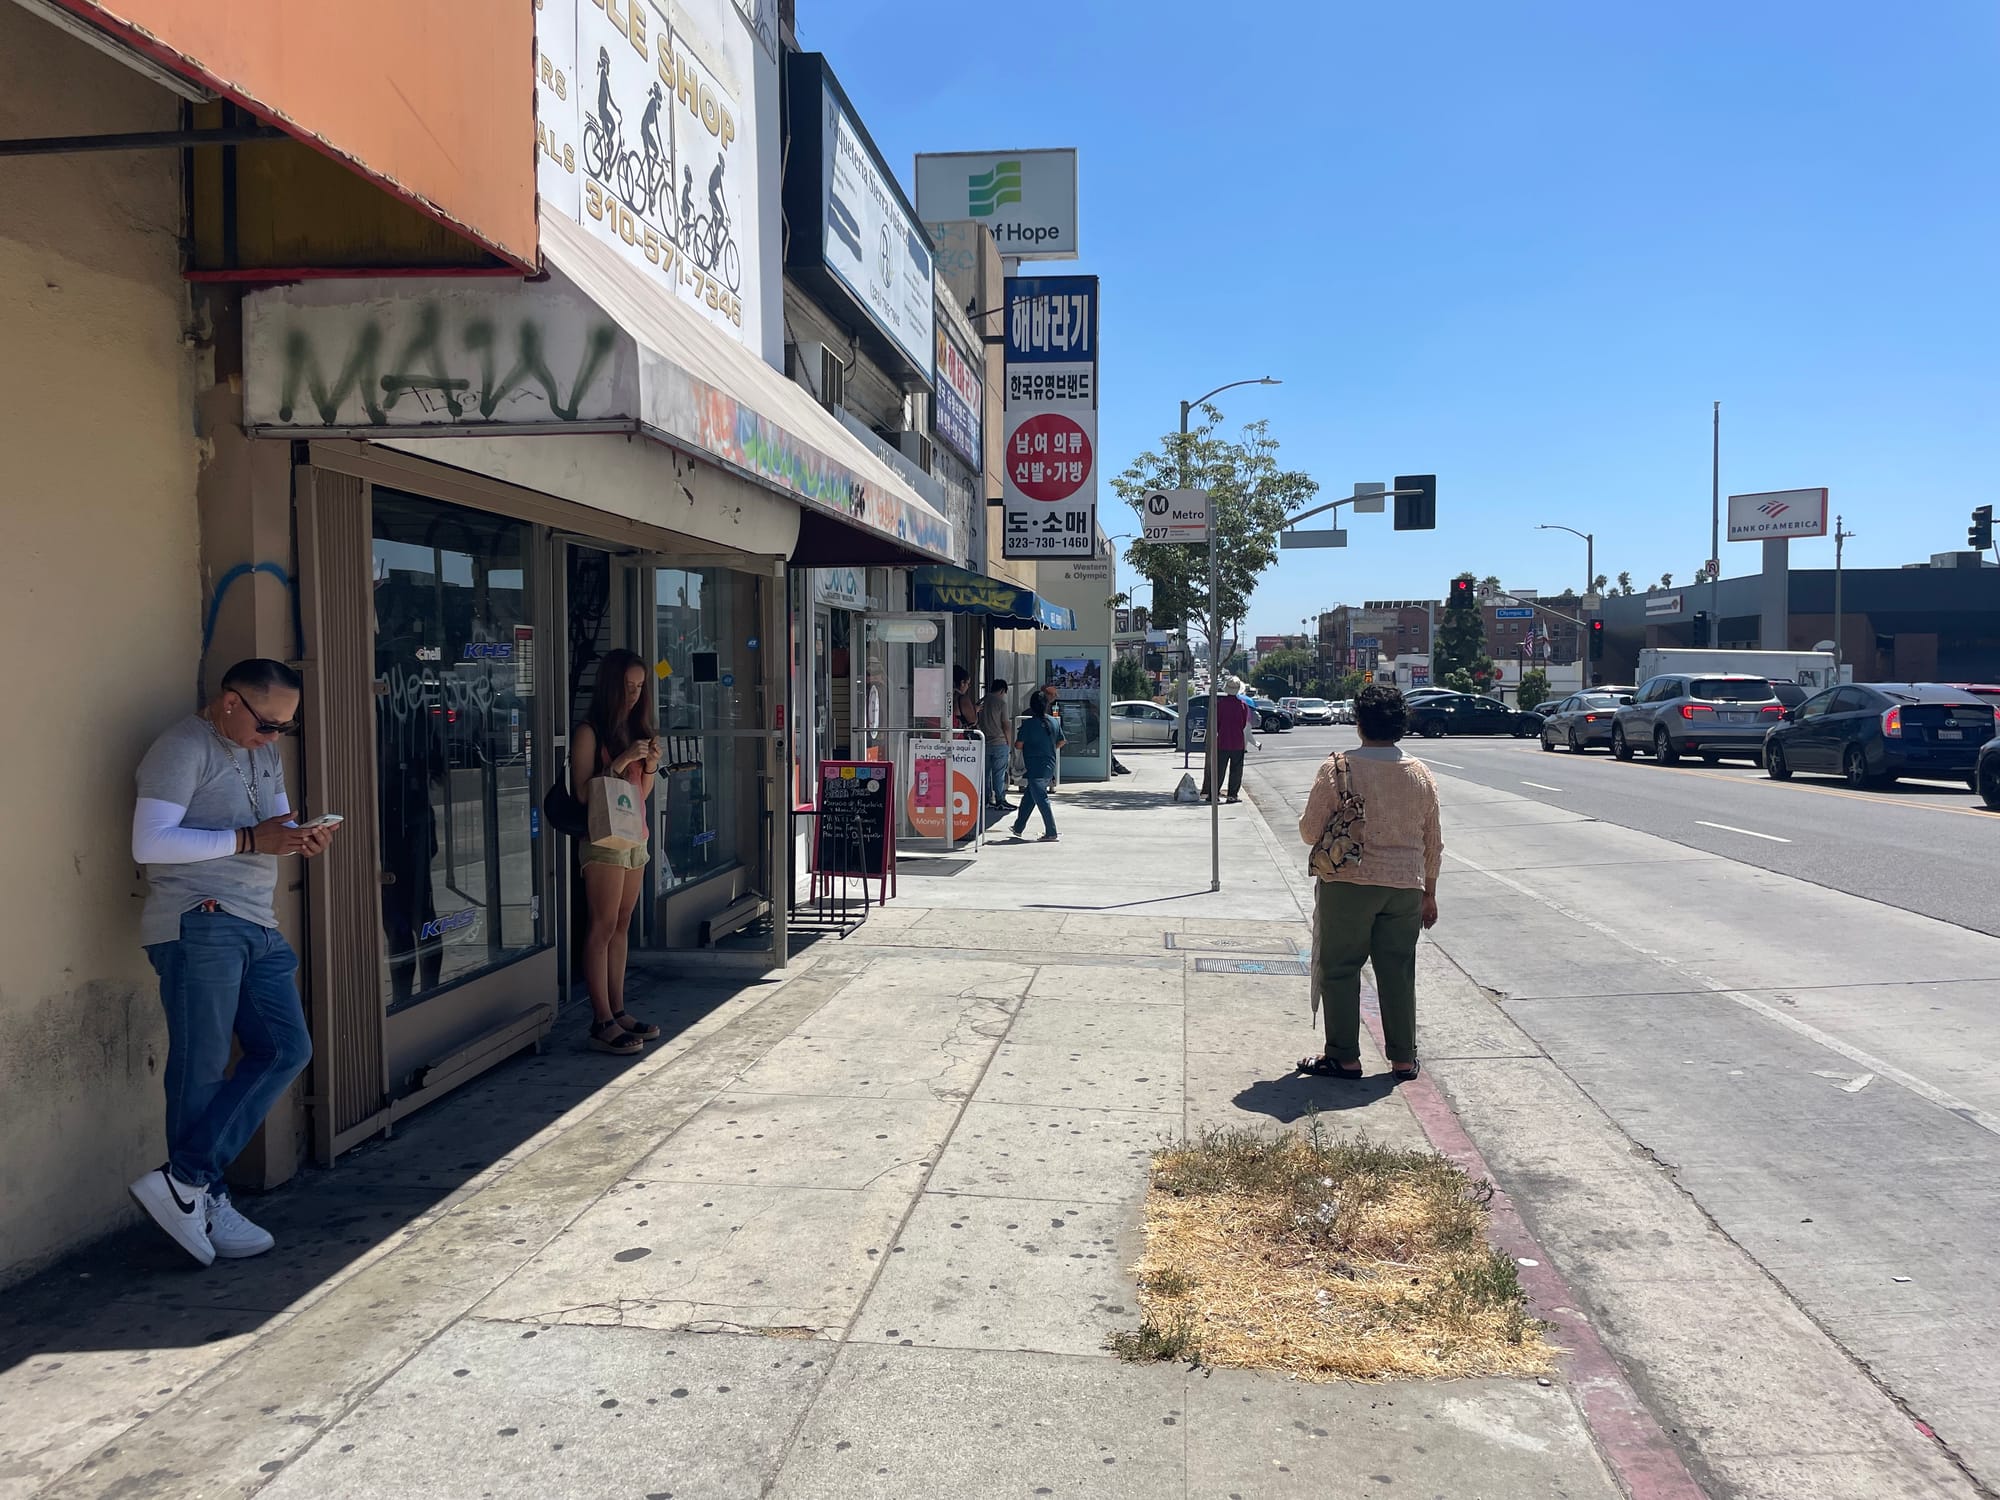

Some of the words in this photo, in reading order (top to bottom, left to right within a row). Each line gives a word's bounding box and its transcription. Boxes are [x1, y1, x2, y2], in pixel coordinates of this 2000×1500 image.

[657, 32, 735, 151] SHOP
[868, 168, 888, 217] Sierra
[1007, 223, 1059, 244] Hope
[585, 178, 741, 327] 310-571-7346
[1012, 295, 1088, 352] 해바라기
[1011, 375, 1088, 400] 한국유명브랜드
[1016, 433, 1047, 455] 남,여
[1054, 433, 1082, 454] 의류
[1172, 510, 1204, 519] Metro
[1145, 527, 1168, 539] 207
[1731, 525, 1756, 533] BANK
[1758, 523, 1771, 531] OF
[1772, 521, 1818, 530] AMERICA
[1008, 537, 1088, 548] 323-730-1460
[1073, 563, 1107, 571] Western
[1073, 572, 1107, 580] Olympic
[464, 643, 512, 659] KHS
[916, 818, 940, 827] Money
[421, 906, 477, 940] KHS
